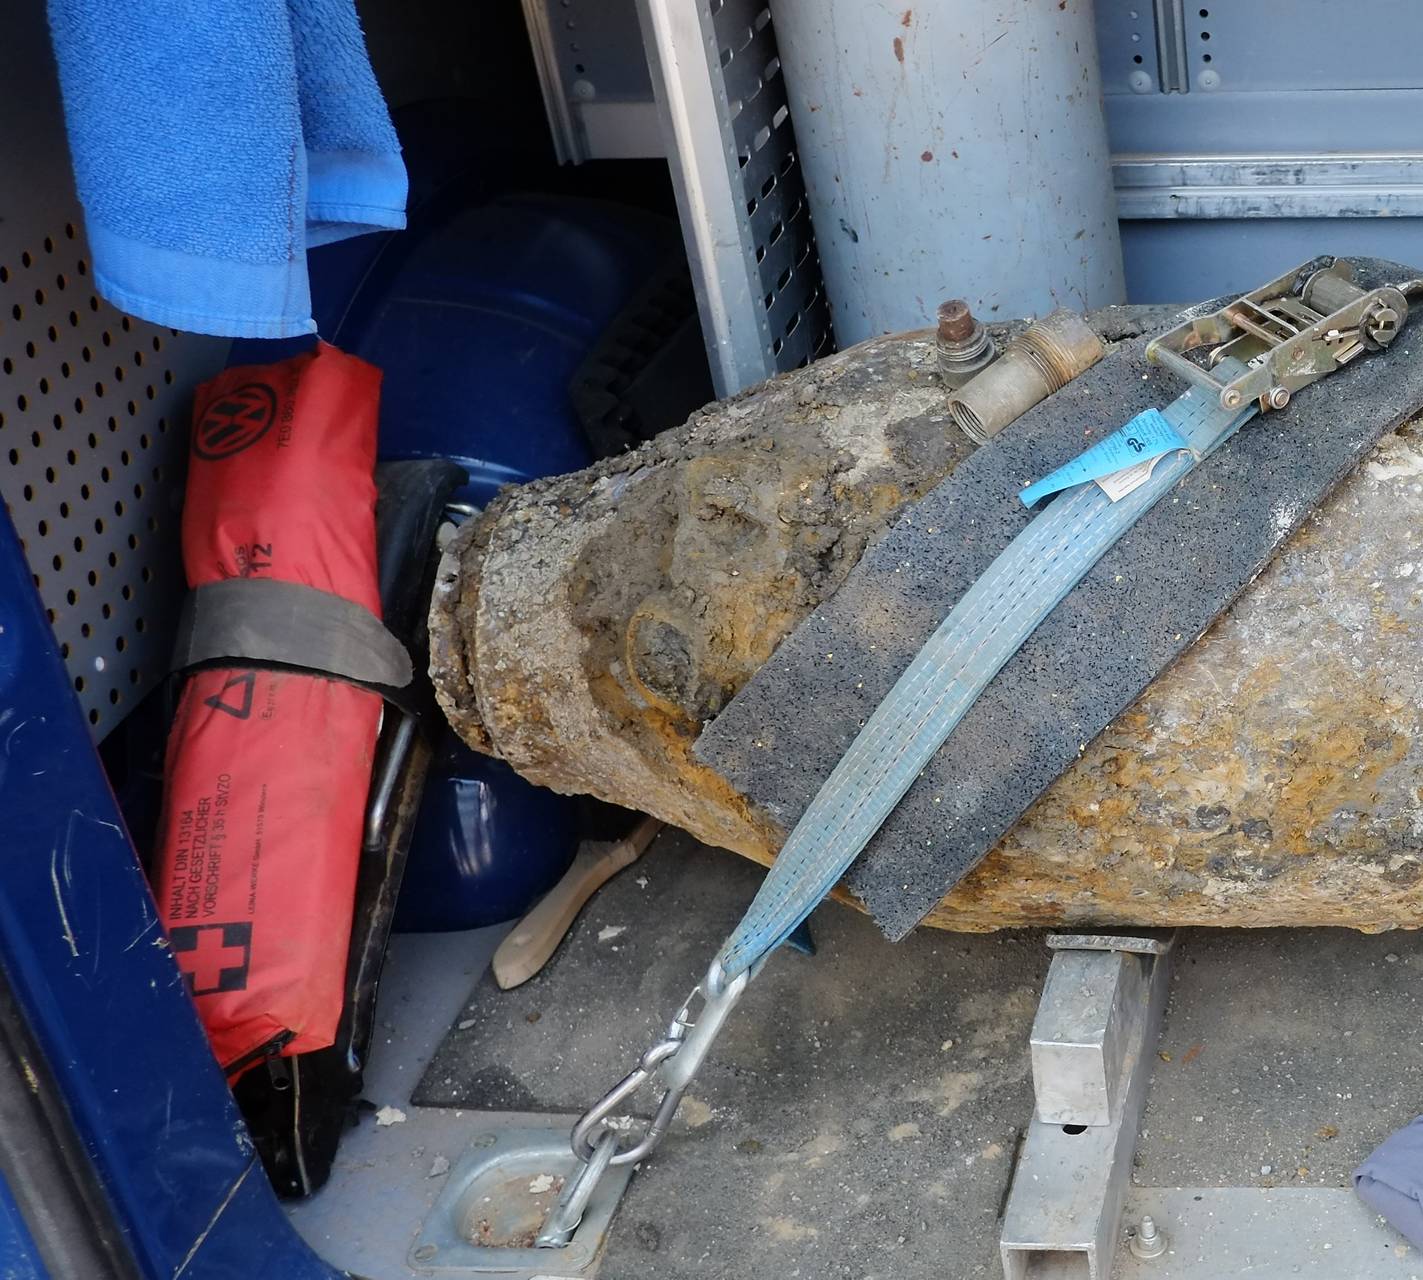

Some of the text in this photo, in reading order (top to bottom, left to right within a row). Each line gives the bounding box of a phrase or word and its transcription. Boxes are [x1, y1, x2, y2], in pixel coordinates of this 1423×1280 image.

[212, 817, 225, 831] 35
[215, 774, 231, 808] StVZO
[169, 810, 193, 920] INHALT DIN 13164
[186, 797, 211, 918] NACH GESETZLICHER
[203, 844, 222, 918] VORSCHRIFT
